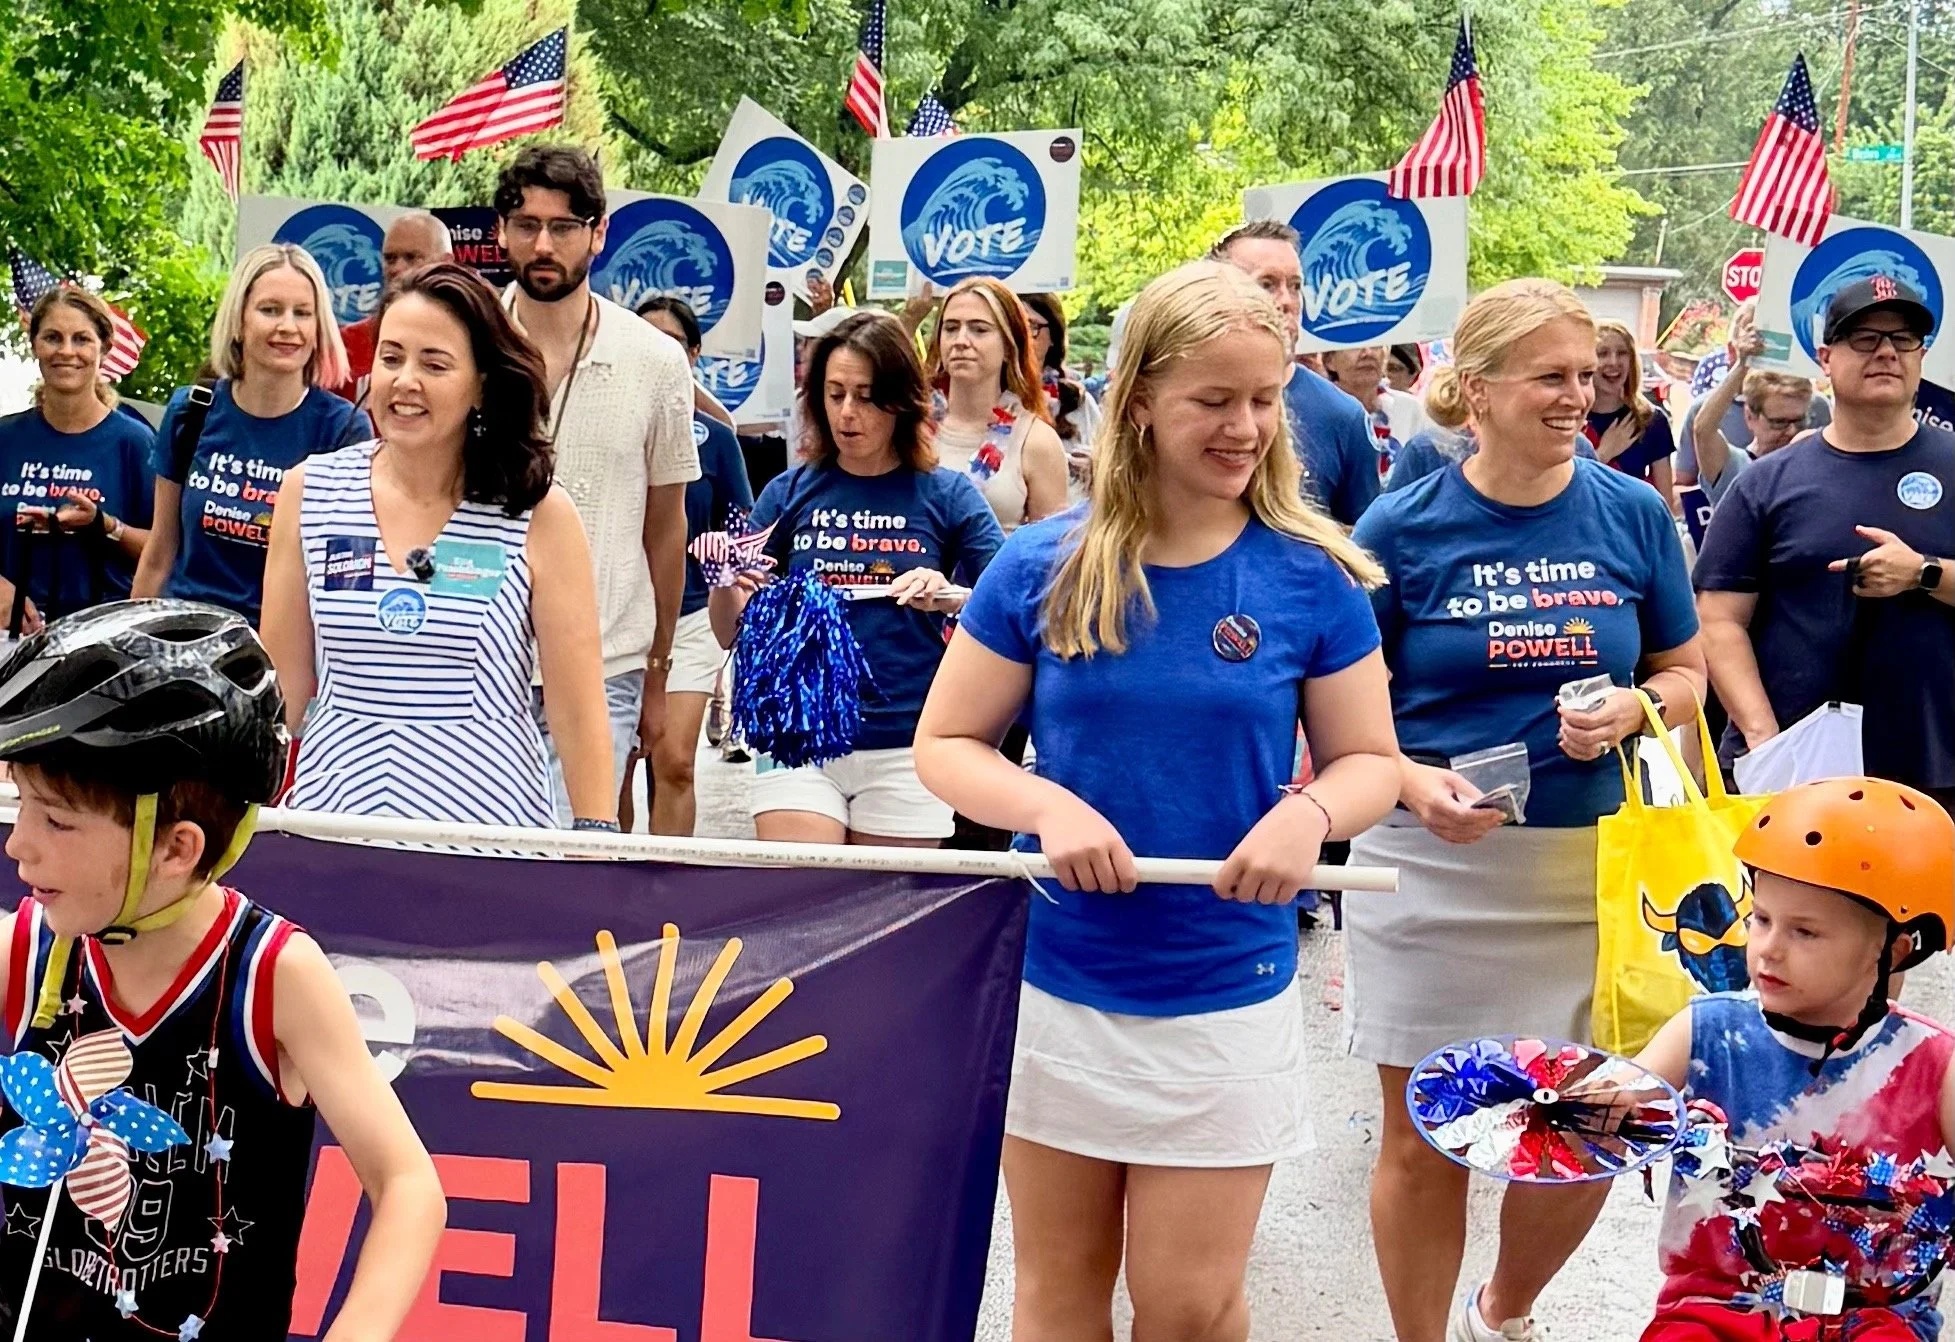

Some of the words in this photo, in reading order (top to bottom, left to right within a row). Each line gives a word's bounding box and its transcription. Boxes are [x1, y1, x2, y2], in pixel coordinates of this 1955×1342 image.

[923, 217, 1027, 268] VOTE
[329, 282, 381, 314] TE
[1303, 261, 1412, 322] VOTE
[21, 462, 50, 480] It's
[52, 463, 93, 481] time
[209, 452, 243, 475] It's
[1, 483, 21, 496] to
[22, 480, 48, 497] be
[188, 471, 210, 490] to
[211, 474, 240, 497] be
[204, 500, 252, 522] Denise
[812, 508, 848, 529] It's
[852, 509, 907, 529] time
[793, 533, 813, 551] to
[816, 530, 847, 551] be
[851, 533, 927, 554] brave.
[813, 557, 866, 573] Denise
[1473, 561, 1522, 587] It's
[1524, 557, 1596, 583] time
[1446, 596, 1483, 618] to
[1487, 590, 1528, 612] be
[1488, 620, 1557, 638] Denise
[1488, 636, 1598, 660] POWELL
